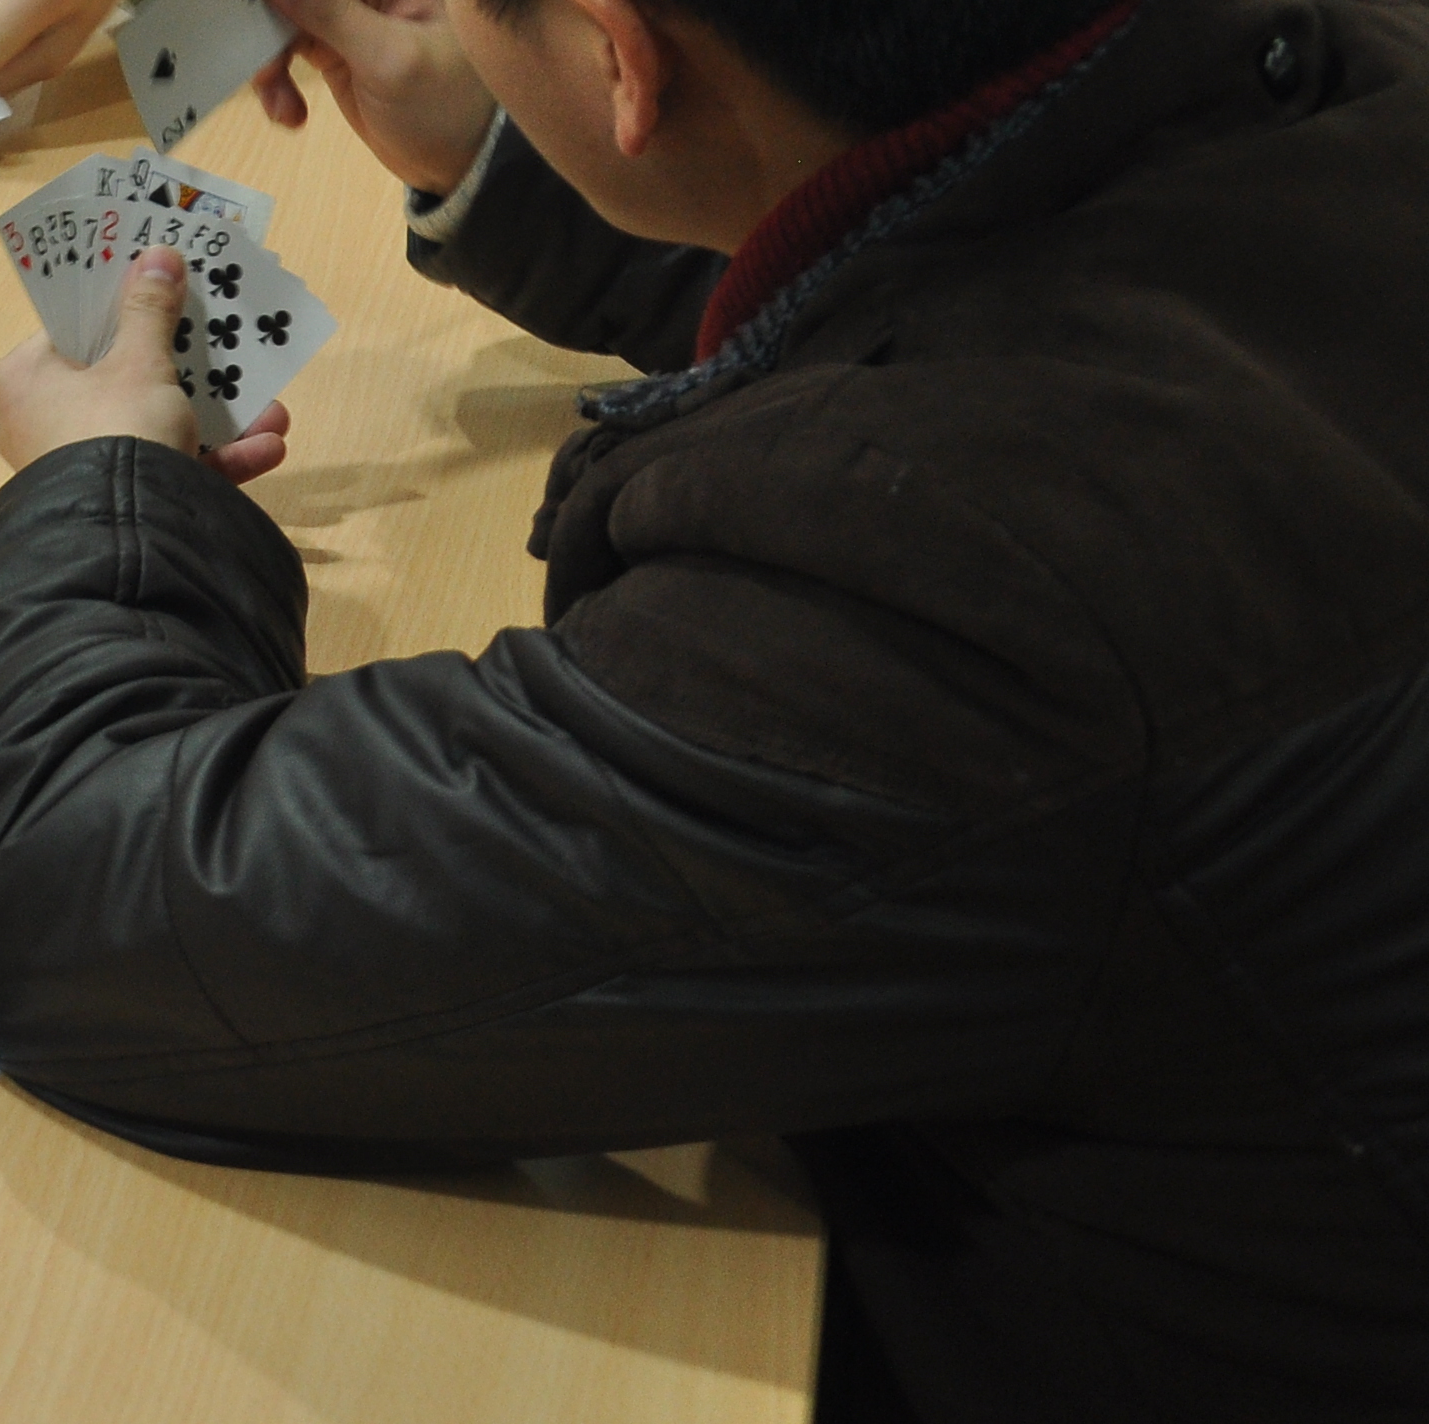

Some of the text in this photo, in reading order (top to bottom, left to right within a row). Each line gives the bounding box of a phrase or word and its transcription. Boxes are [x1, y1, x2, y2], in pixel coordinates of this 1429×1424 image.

[95, 167, 116, 196] K
[129, 158, 151, 190] Q
[29, 224, 48, 256] 8
[61, 210, 78, 241] 5
[83, 217, 98, 249] 7
[102, 210, 119, 241] 2
[132, 215, 152, 246] A
[161, 217, 184, 246] 3
[206, 230, 231, 257] 8
